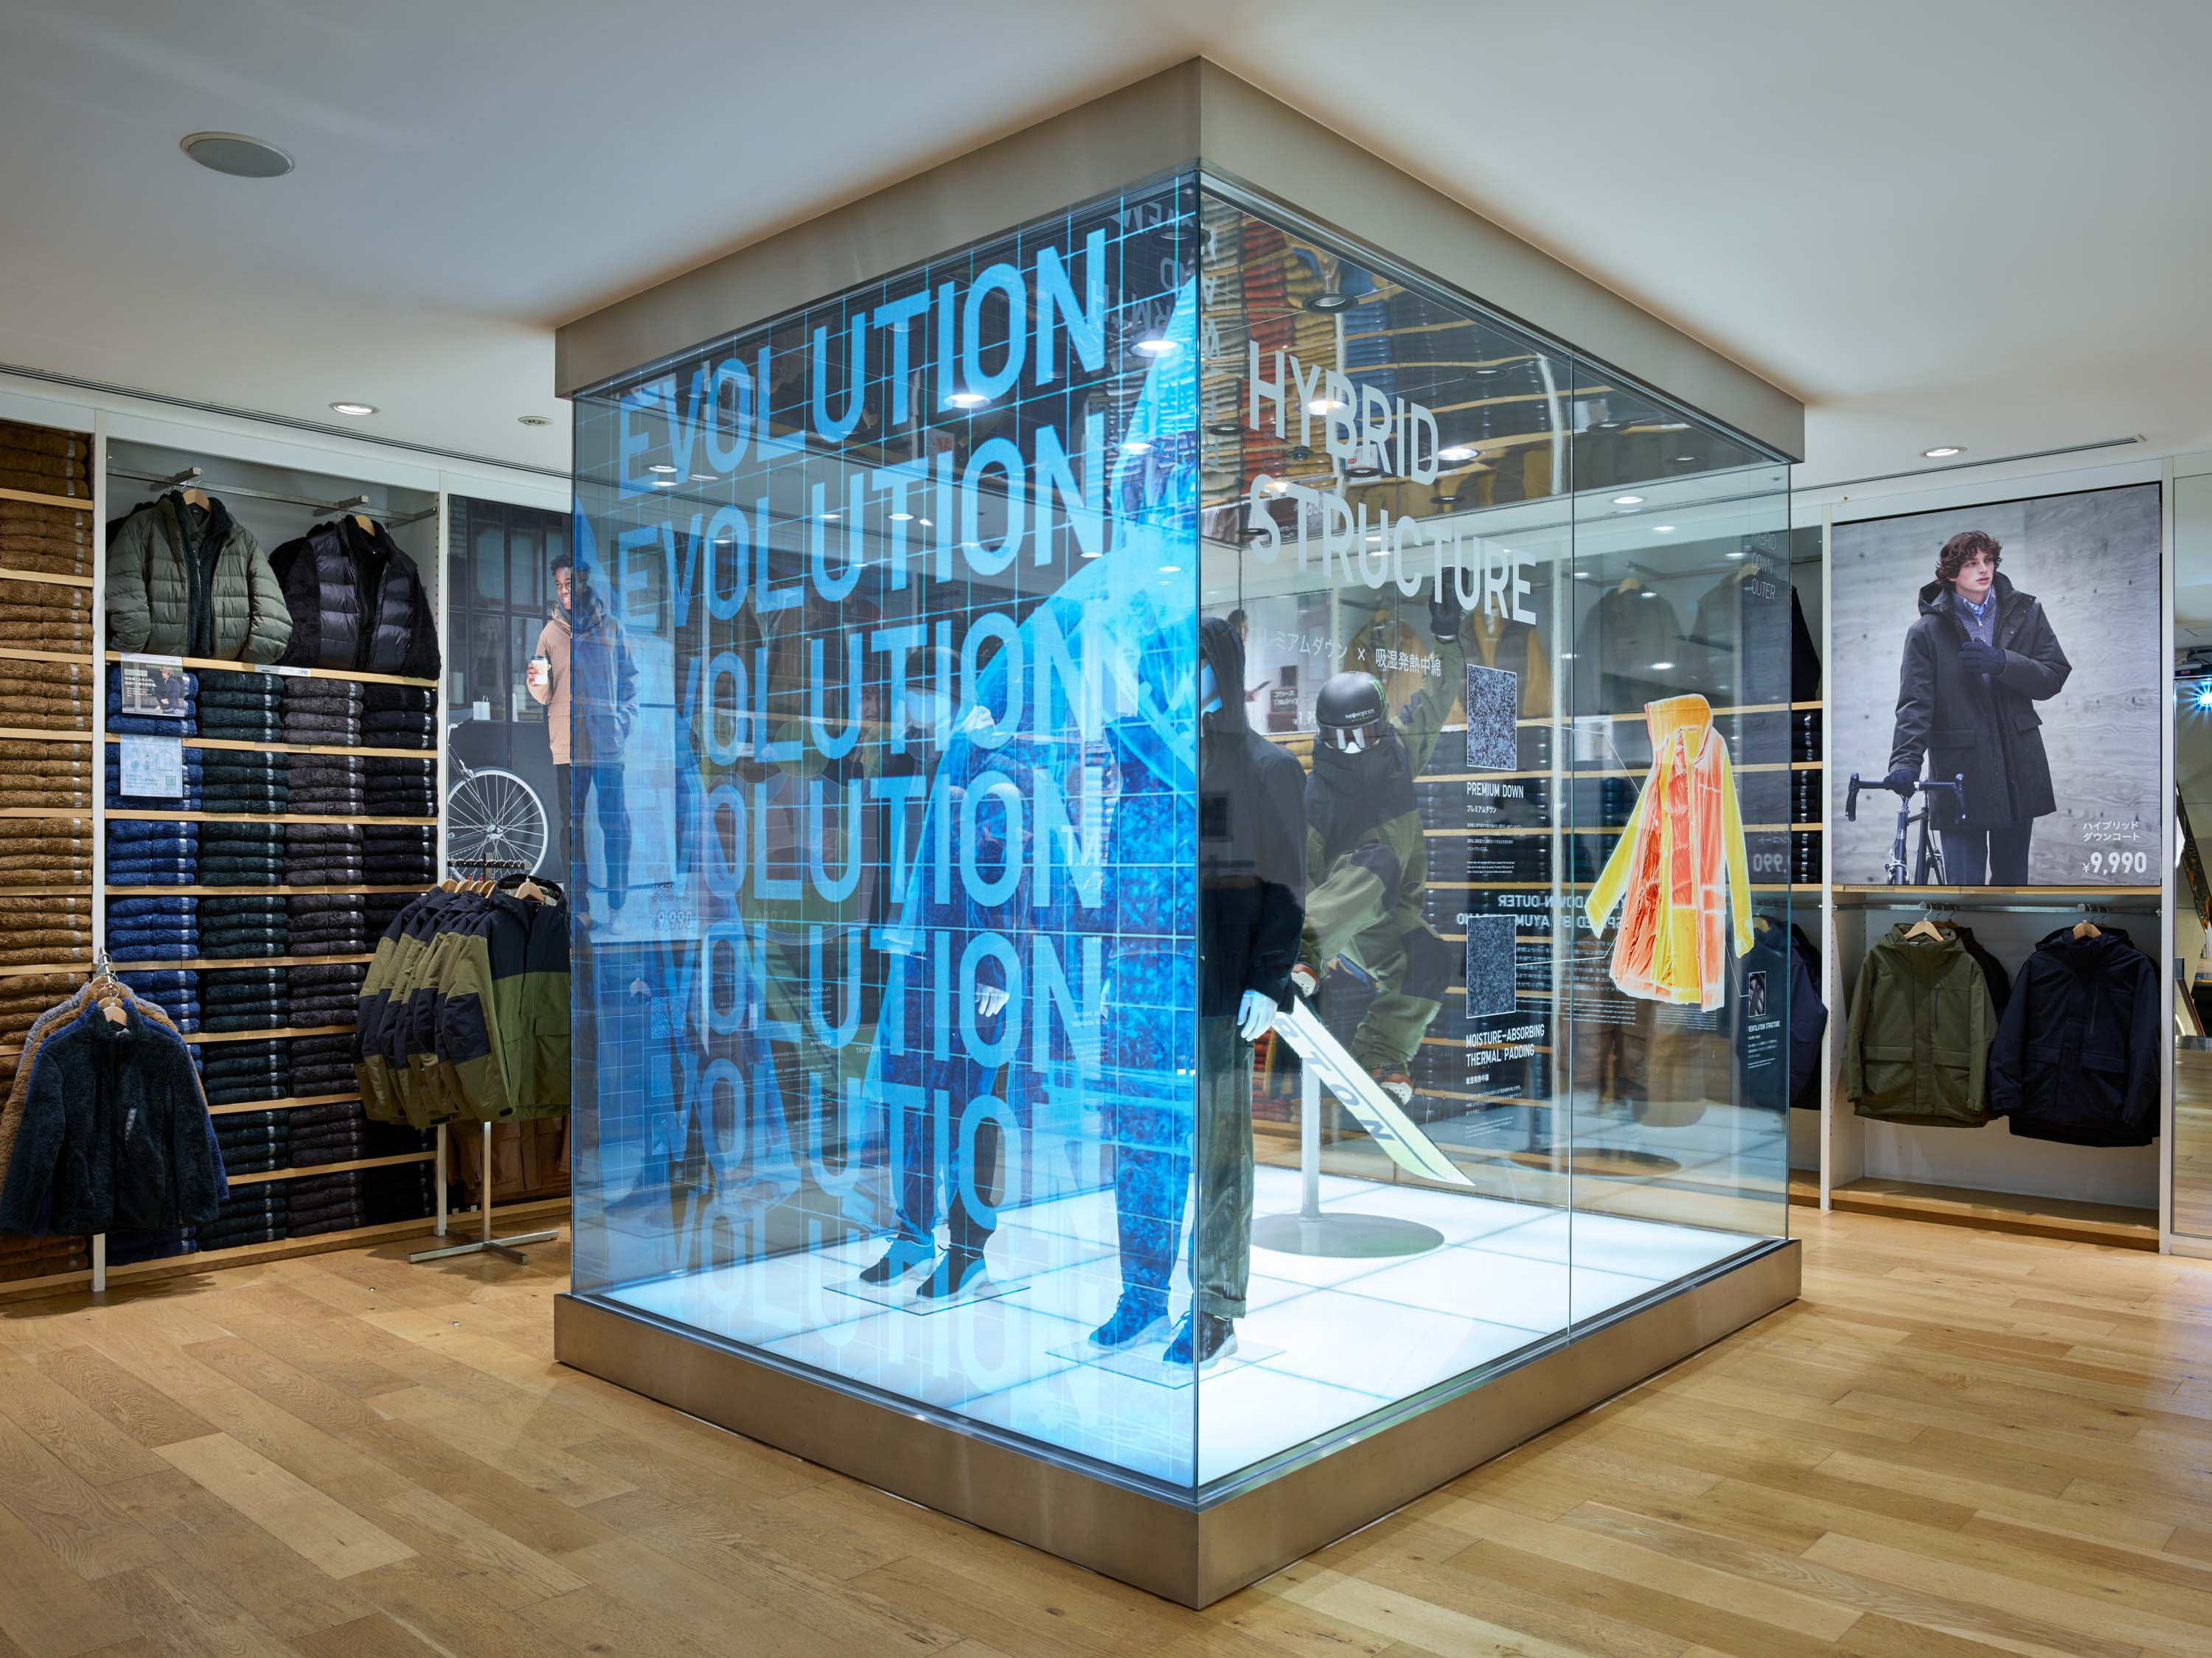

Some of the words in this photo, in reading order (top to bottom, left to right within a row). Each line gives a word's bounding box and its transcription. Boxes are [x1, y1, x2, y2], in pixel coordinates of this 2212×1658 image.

[619, 227, 1105, 501] EVOLUTION
[1249, 340, 1439, 485] HYBRID
[617, 411, 1104, 638] EVOLUTION
[1250, 473, 1536, 624] STRUCTURE
[1752, 579, 1775, 601] OUTER
[1375, 648, 1441, 677] 吸湿発熱中綿
[1467, 781, 1500, 797] PREMIUM
[1503, 784, 1524, 798] DOWN
[1467, 805, 1497, 814] プレミアムダウン
[2083, 821, 2139, 830] ハイブリッド
[2083, 832, 2140, 841] ダウンコート
[2083, 851, 2147, 875] ¥9,990
[1466, 1024, 1545, 1048] MOISTURE-ABSORBING
[1467, 1049, 1502, 1067] THERMAL
[1504, 1044, 1534, 1061] PADDING
